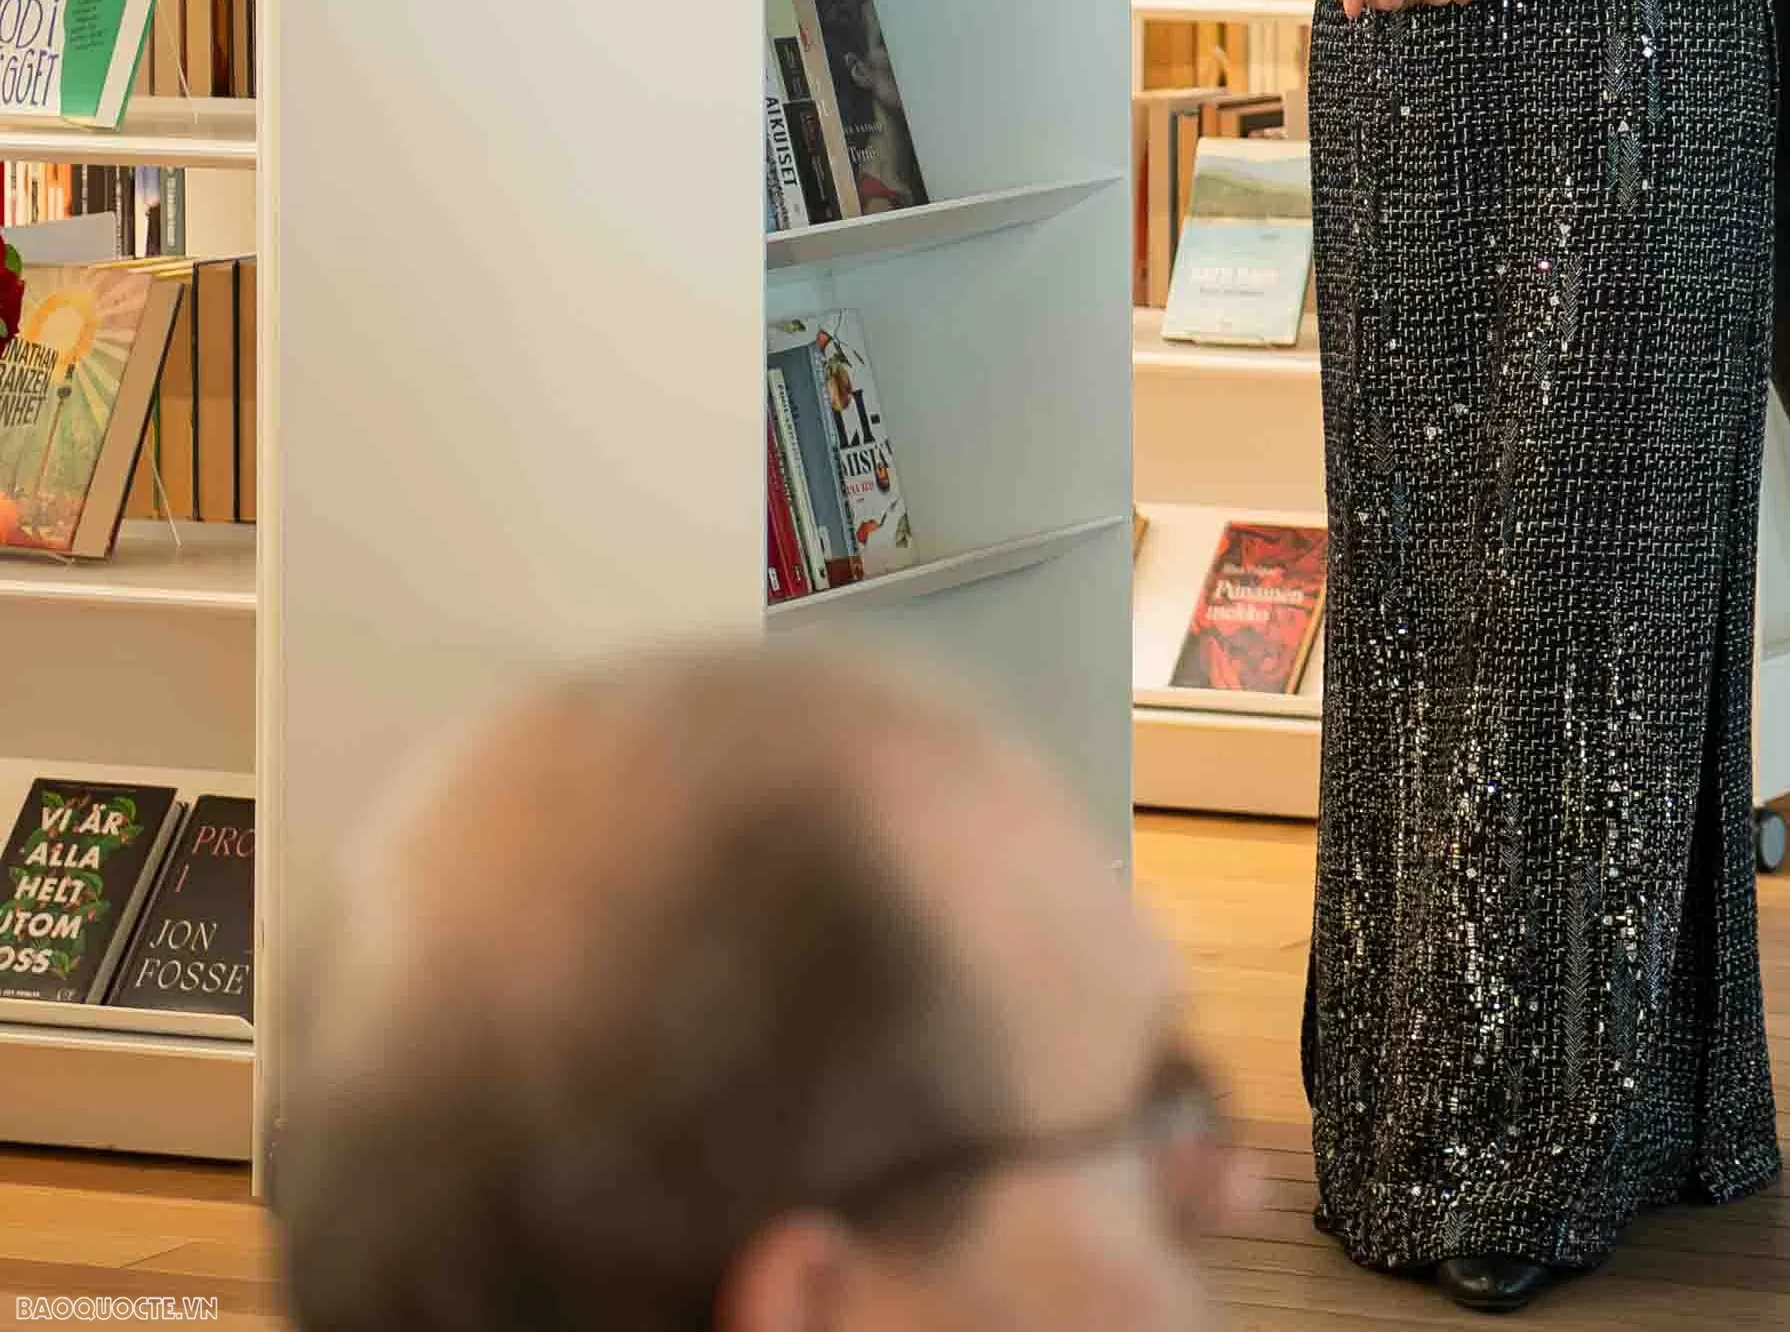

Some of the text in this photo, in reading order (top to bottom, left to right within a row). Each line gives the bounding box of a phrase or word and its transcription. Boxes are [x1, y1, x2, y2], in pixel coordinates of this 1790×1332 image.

[0, 47, 60, 106] GGET
[41, 803, 124, 836] VI ÄR
[24, 840, 101, 869] ALLA
[14, 874, 86, 904] HELT
[149, 918, 218, 952] JON
[0, 946, 53, 974] OSS
[135, 957, 250, 996] FOSSE
